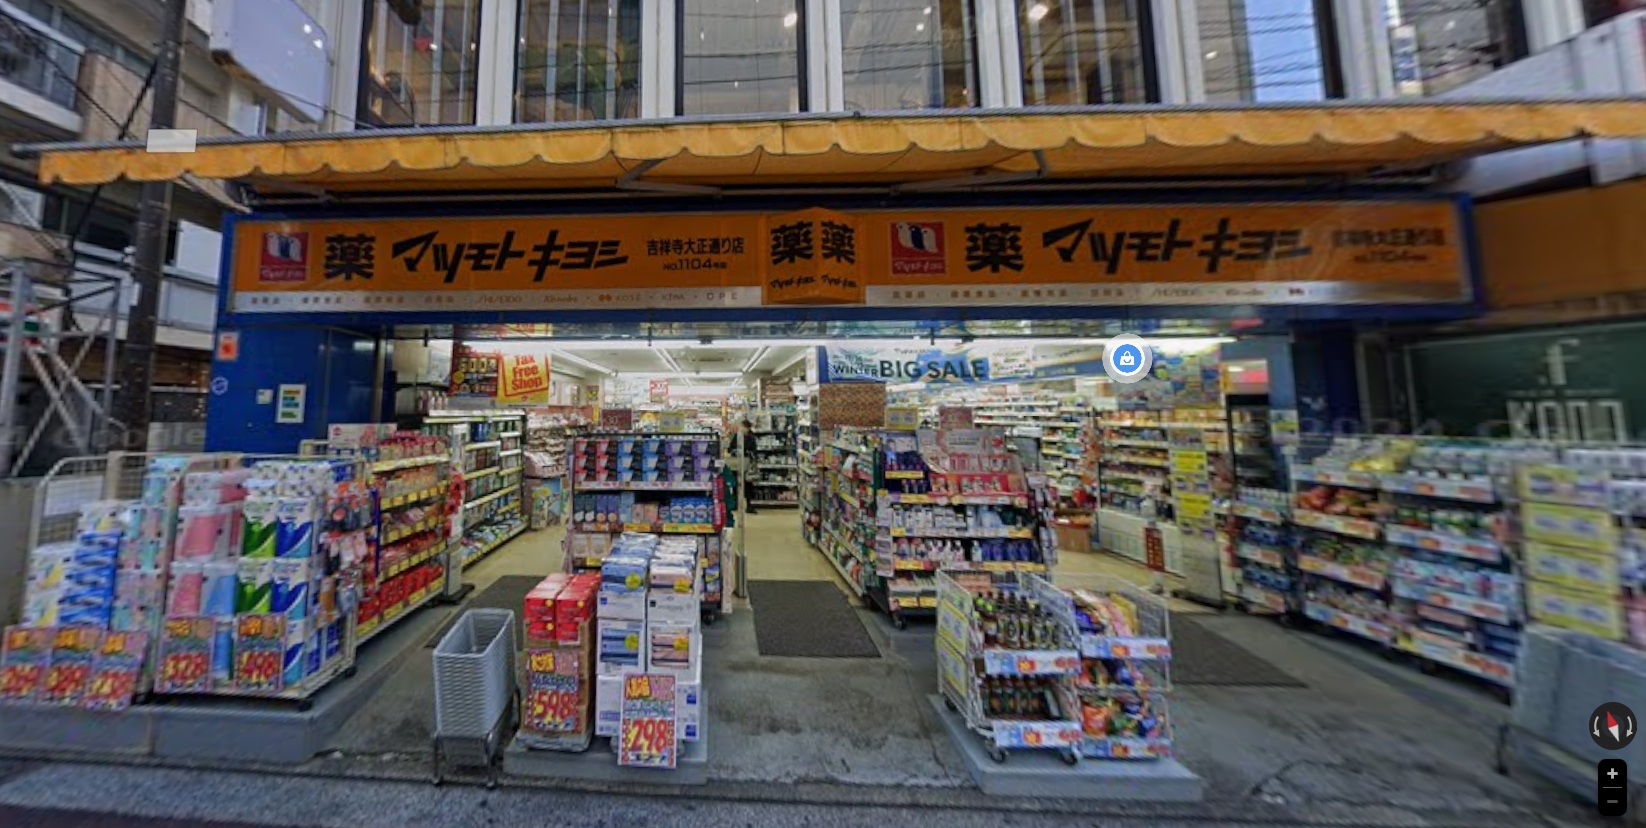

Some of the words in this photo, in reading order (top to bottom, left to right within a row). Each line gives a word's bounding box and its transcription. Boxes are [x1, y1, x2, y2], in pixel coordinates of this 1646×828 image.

[646, 237, 745, 256] 吉祥寺大正通り店
[771, 221, 813, 265] 薬
[821, 221, 855, 264] 薬
[964, 222, 1024, 273] 薬
[1042, 217, 1312, 275] マツモトキヨシ
[324, 233, 376, 281] 薬
[392, 229, 629, 283] マツモトキヨシ
[511, 364, 539, 378] Free
[513, 353, 535, 365] Tax
[833, 364, 879, 377] WINTER
[879, 360, 922, 378] BIG
[927, 359, 985, 379] SALE
[511, 376, 543, 391] Shop
[537, 691, 574, 719] 598
[631, 719, 668, 753] 298
